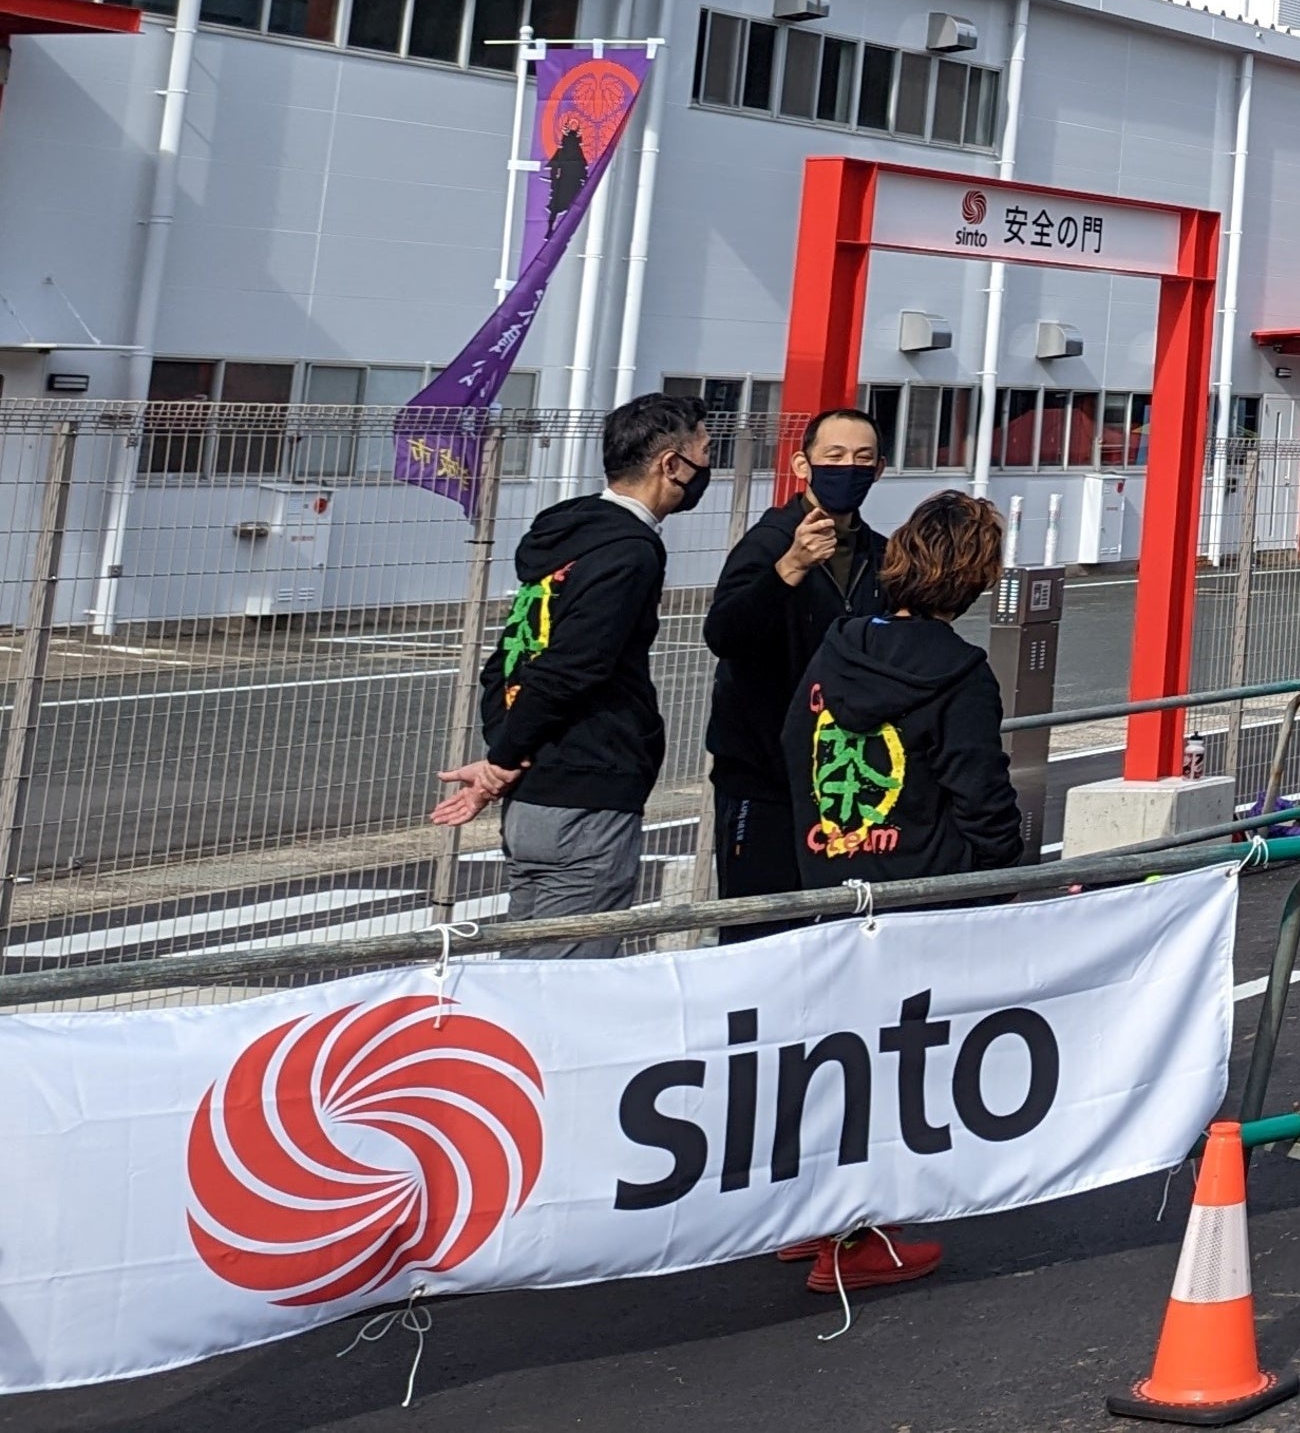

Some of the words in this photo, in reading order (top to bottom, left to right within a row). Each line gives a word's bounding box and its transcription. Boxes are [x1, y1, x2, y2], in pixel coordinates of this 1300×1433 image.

[955, 227, 988, 248] sinto
[1003, 206, 1104, 254] 安全の門
[613, 989, 1060, 1211] sinto
